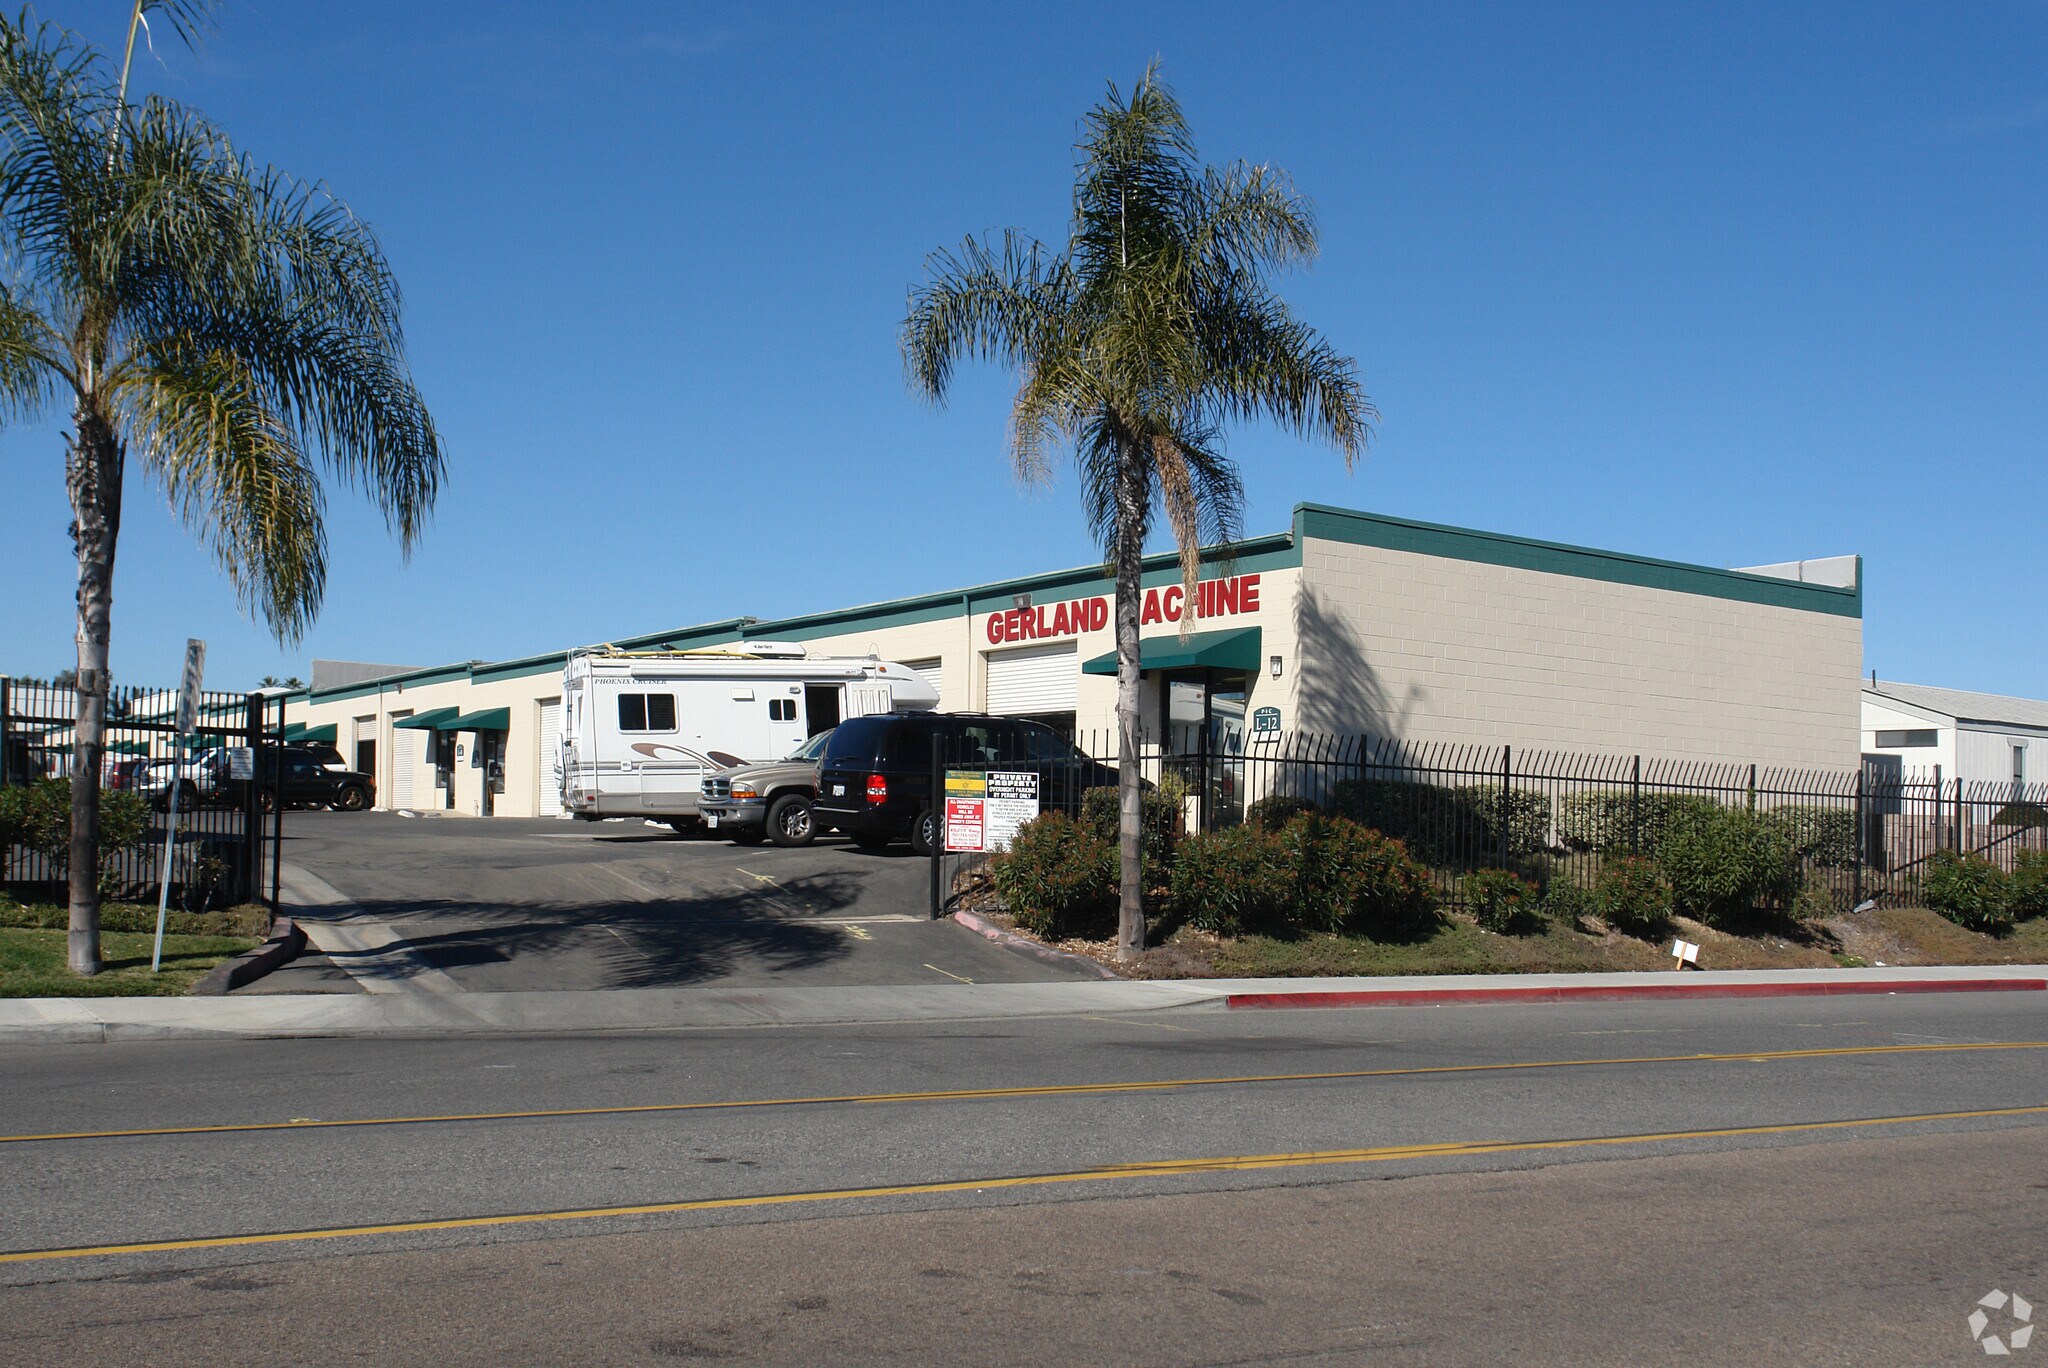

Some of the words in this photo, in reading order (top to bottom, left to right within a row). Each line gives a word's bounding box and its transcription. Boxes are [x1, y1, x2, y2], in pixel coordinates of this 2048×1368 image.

[987, 597, 1109, 645] GERLAND
[1141, 574, 1261, 626] ACINE
[1256, 717, 1277, 730] L-12
